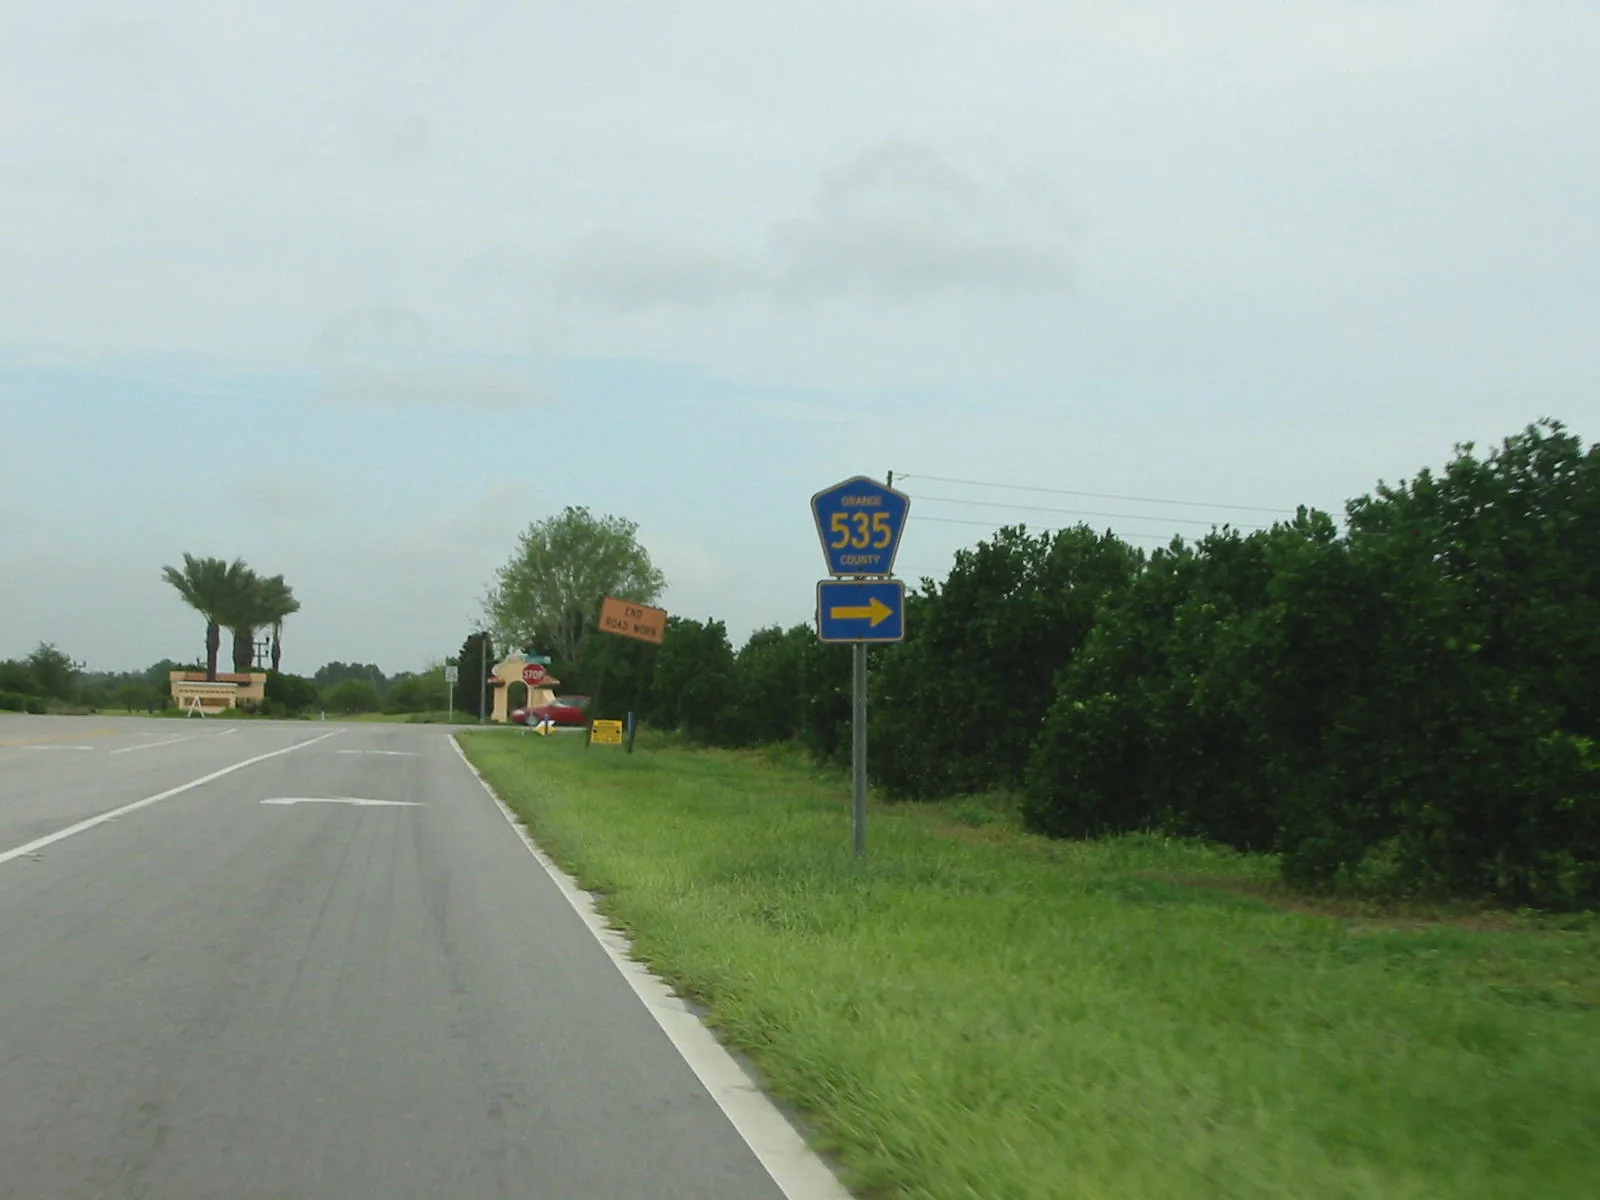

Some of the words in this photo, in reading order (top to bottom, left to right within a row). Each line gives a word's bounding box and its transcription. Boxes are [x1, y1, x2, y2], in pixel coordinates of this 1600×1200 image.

[842, 496, 882, 506] ORANGE
[831, 512, 892, 548] 535
[840, 555, 881, 565] COUNTY
[624, 606, 643, 619] END
[606, 616, 628, 630] ROAD
[633, 623, 657, 636] WORK
[523, 670, 544, 680] STOP
